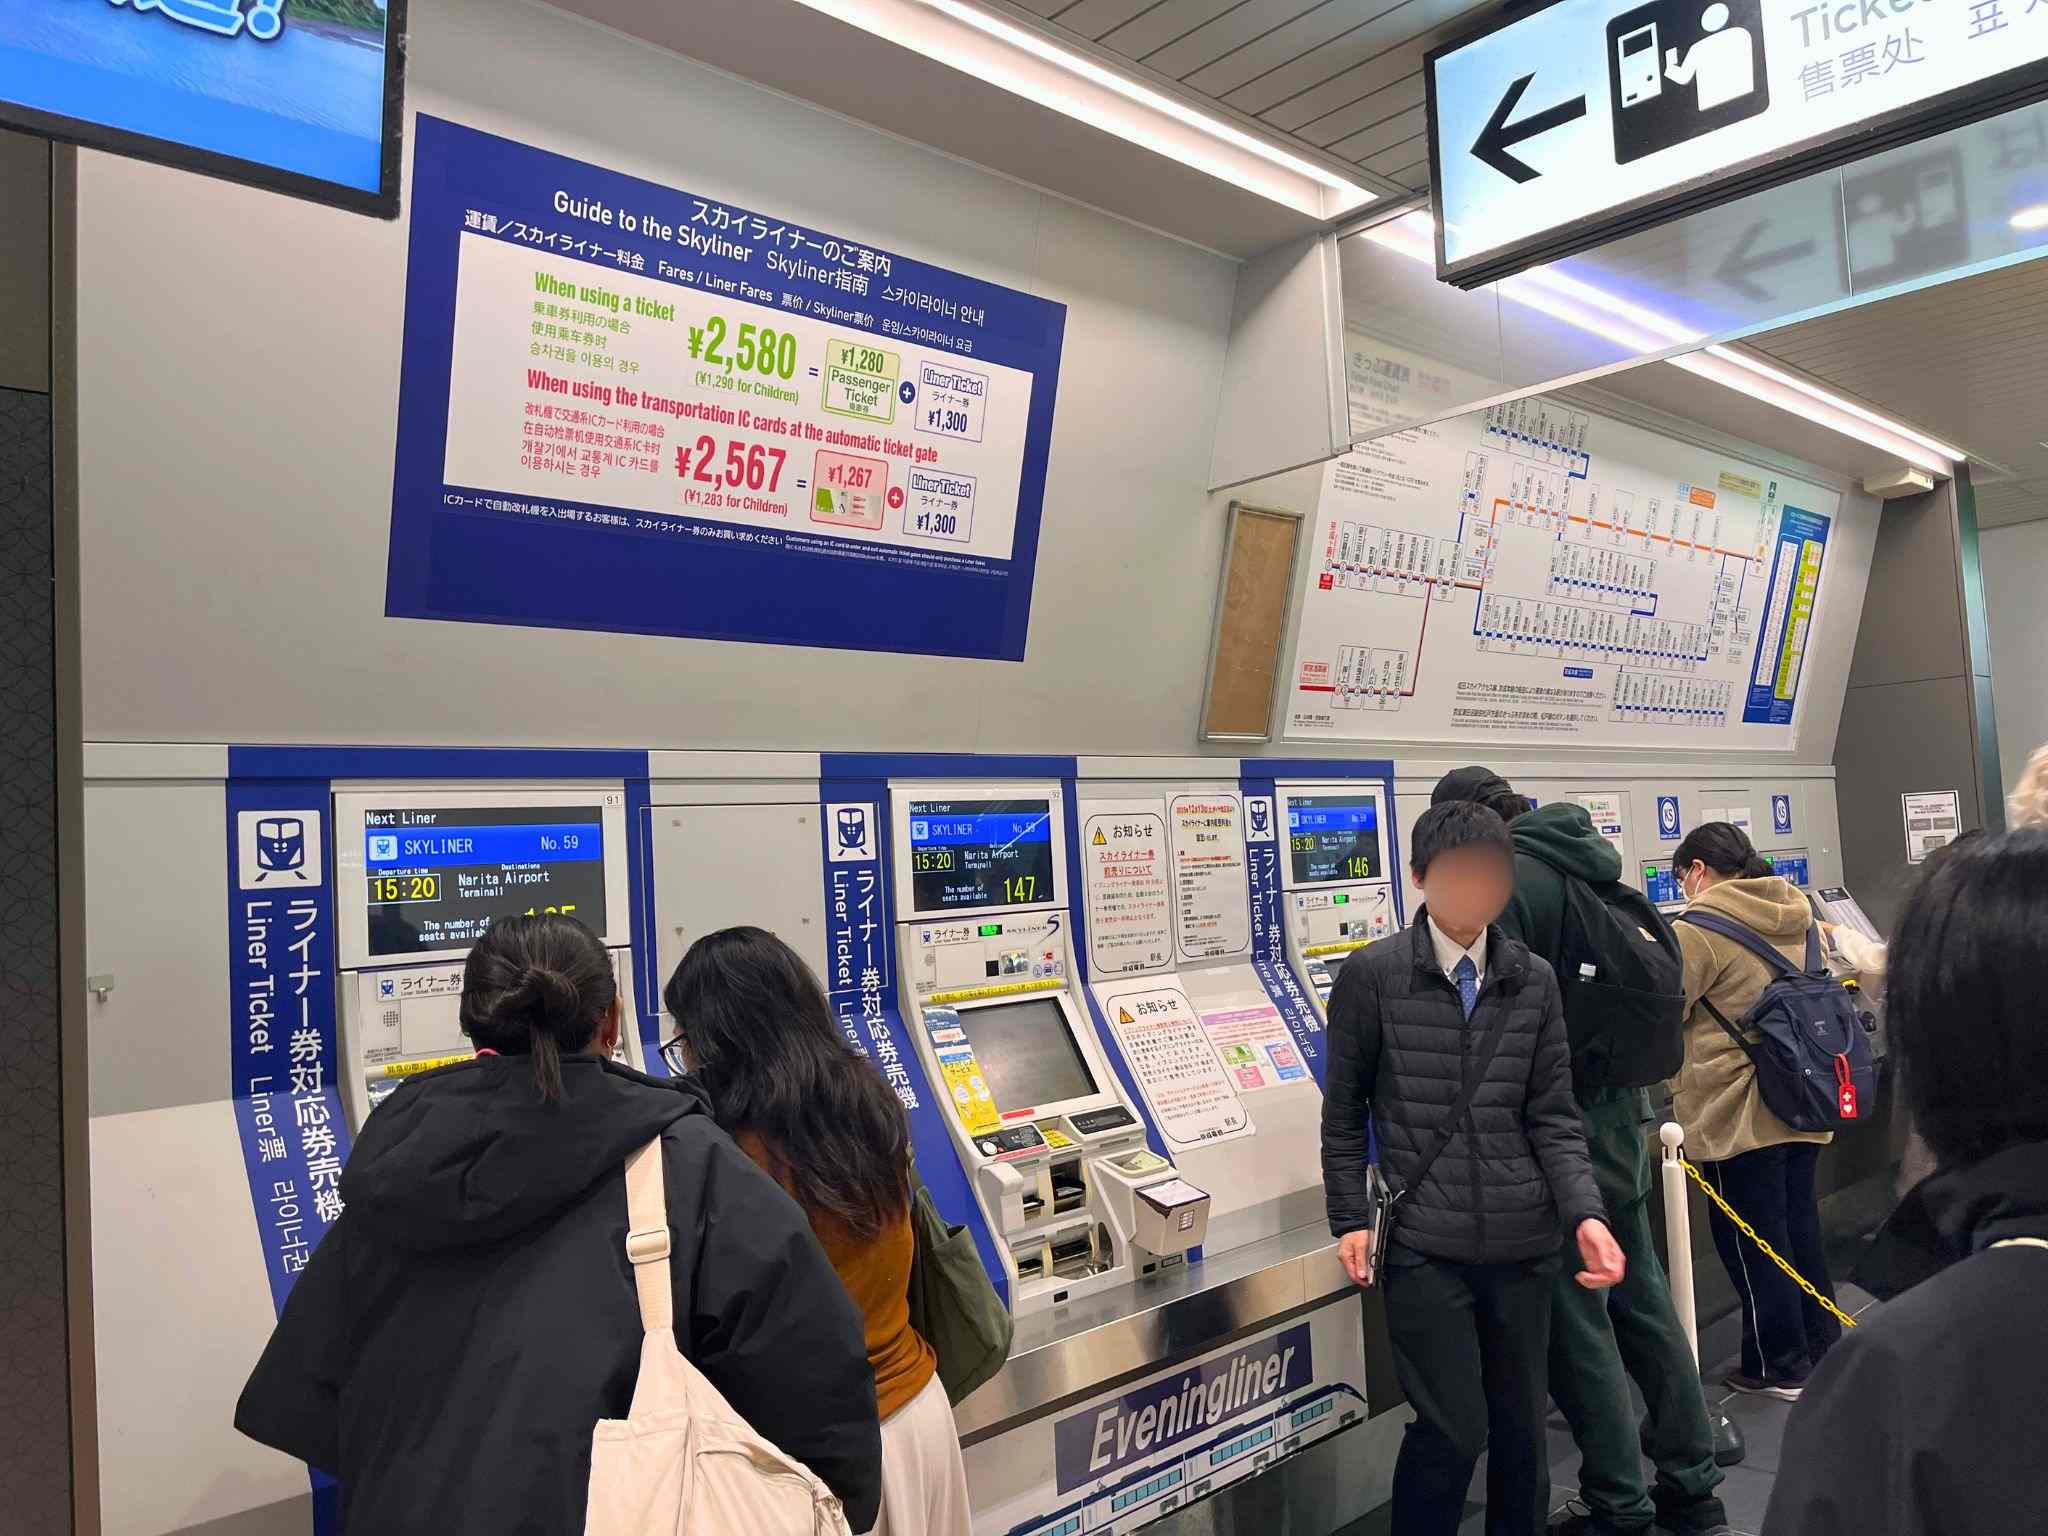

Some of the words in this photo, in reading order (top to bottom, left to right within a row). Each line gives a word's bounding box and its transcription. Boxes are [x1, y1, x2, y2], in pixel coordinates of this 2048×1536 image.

[1798, 27, 1925, 102] 售票处
[464, 208, 645, 271] 運賃／スカイライナー料金
[554, 190, 612, 225] Guide
[618, 209, 637, 231] to
[642, 213, 672, 241] the
[677, 225, 753, 263] Skyliner
[690, 200, 892, 278] スカイライナーのご案内
[658, 260, 694, 283] Fares
[697, 271, 703, 284] /
[705, 272, 737, 294] Liner
[740, 282, 773, 302] Fares
[766, 250, 869, 296] Skyliner指南
[535, 271, 577, 298] When
[580, 283, 620, 313] using
[623, 297, 632, 311] a
[635, 296, 676, 322] ticket
[781, 292, 804, 310] 票价
[813, 299, 874, 328] Skyliner票价
[881, 284, 957, 320] 스카이라이너
[960, 304, 985, 327] 안내
[533, 301, 631, 335] 乗車券利用の場合
[688, 316, 797, 380] ¥2,580
[881, 318, 954, 348] 운임/스카이라이너
[955, 335, 973, 352] 요금
[530, 342, 577, 363] 승차권을
[580, 350, 614, 371] 이용의
[618, 358, 640, 375] 경우
[841, 347, 884, 374] ¥1,280
[695, 371, 734, 391] (¥1,290
[737, 380, 752, 393] for
[753, 381, 799, 405] Children)
[831, 370, 891, 394] Passenger
[923, 368, 951, 388] Liner
[951, 376, 983, 396] Ticket
[844, 387, 878, 406] Ticket
[931, 391, 969, 408] ライナー券
[524, 402, 665, 438] 改札機で交通系ICカード利用の場合
[527, 368, 568, 394] When
[572, 380, 612, 406] using
[616, 384, 638, 407] the
[641, 391, 735, 425] transportation
[738, 409, 751, 428] IC
[753, 415, 788, 437] cards
[790, 423, 803, 438] at
[804, 424, 824, 441] the
[825, 428, 881, 452] automatic
[883, 435, 913, 457] ticket
[915, 443, 938, 463] gate
[928, 407, 968, 433] ¥1,300
[520, 454, 577, 475] 이용하시는
[580, 462, 601, 479] 경우
[521, 438, 578, 461] 개찰기에서
[581, 446, 614, 466] 교통계
[615, 453, 627, 466] IC
[628, 455, 660, 473] 카드를
[674, 434, 787, 494] ¥2,567
[828, 464, 873, 489] ¥1,267
[912, 474, 938, 493] Liner
[939, 478, 971, 498] Ticket
[684, 487, 723, 508] (¥1,283
[726, 493, 741, 508] for
[742, 494, 788, 517] Children)
[920, 495, 959, 512] ライナー券
[916, 512, 956, 535] ¥1,300
[366, 811, 396, 825] Next
[401, 811, 437, 825] Liner
[909, 802, 928, 814] Next
[930, 802, 951, 813] Liner
[932, 824, 973, 836] SKYLINER
[1112, 824, 1153, 839] お知らせ
[1291, 837, 1314, 851] 15:20
[404, 838, 473, 855] SKYLINER
[541, 835, 579, 850] No.59
[964, 849, 989, 861] Narita
[992, 848, 1019, 860] Airport
[378, 867, 411, 876] Departure
[413, 867, 429, 875] time
[915, 852, 951, 870] 15:20
[1249, 848, 1259, 888] Liner
[1347, 856, 1369, 877] 146
[374, 876, 436, 900] 15:20
[458, 872, 499, 887] Narita
[505, 870, 550, 885] Airport
[458, 886, 504, 899] Terminal1
[945, 885, 954, 894] The
[956, 884, 976, 894] number
[977, 883, 984, 893] of
[1003, 876, 1036, 903] 147
[833, 871, 849, 923] Liner
[942, 893, 959, 903] seats
[960, 892, 988, 901] available
[424, 919, 440, 930] The
[444, 918, 476, 929] number
[479, 916, 490, 928] of
[1252, 892, 1264, 936] Ticket
[246, 901, 273, 968] Liner
[418, 932, 445, 942] seats
[449, 929, 487, 940] availab
[836, 928, 851, 985] Ticket
[400, 973, 462, 989] ライナー券
[857, 870, 920, 1110] ライナー券対応券売機
[249, 976, 273, 1054] Ticket
[1136, 999, 1179, 1016] お知らせ
[287, 899, 346, 1223] ライナー券対応券売機
[251, 1076, 287, 1163] Liner票
[271, 1181, 310, 1274] 라이너권
[1089, 1345, 1296, 1473] Eveningliner
